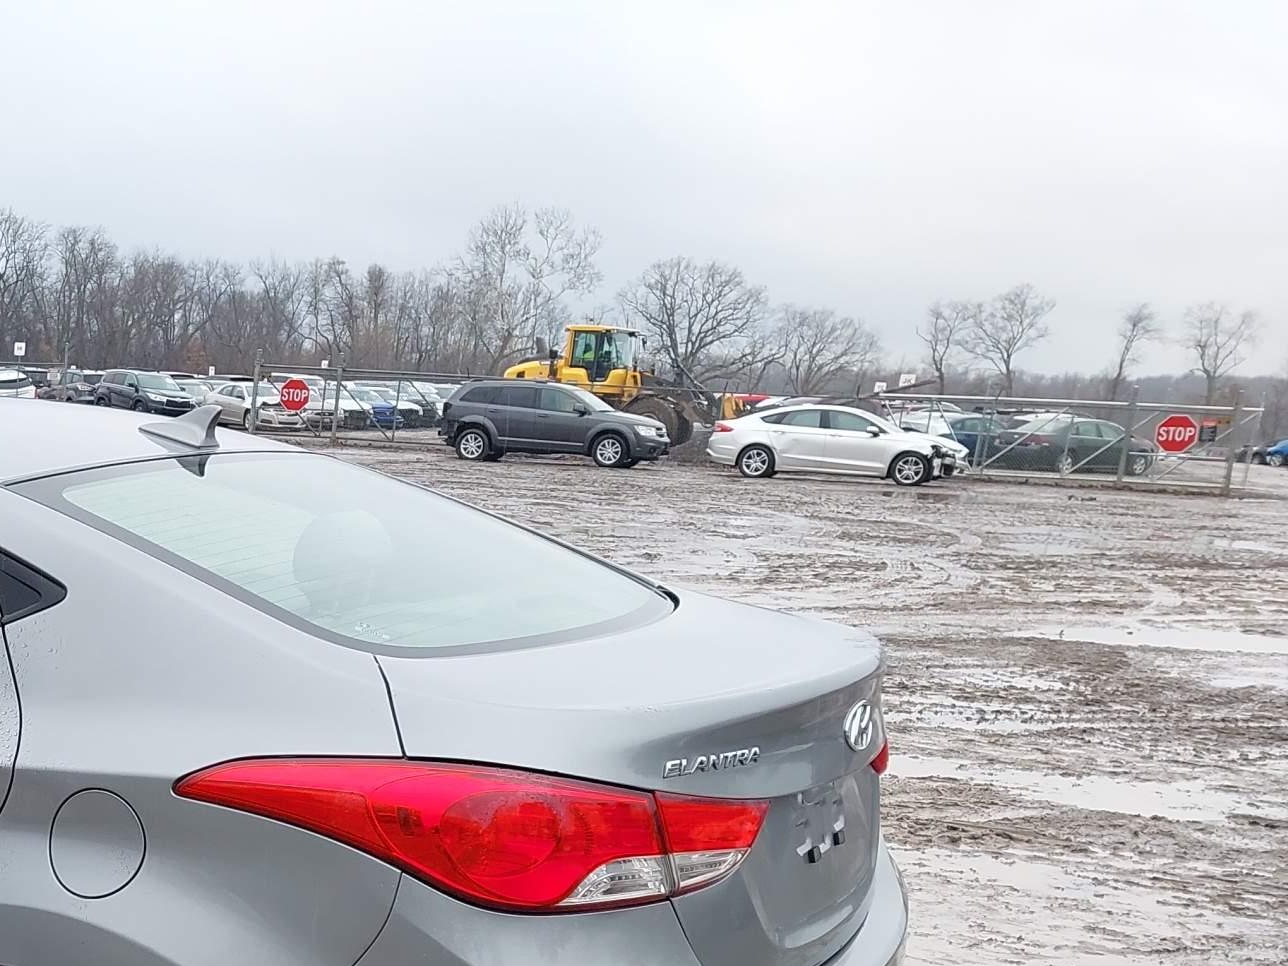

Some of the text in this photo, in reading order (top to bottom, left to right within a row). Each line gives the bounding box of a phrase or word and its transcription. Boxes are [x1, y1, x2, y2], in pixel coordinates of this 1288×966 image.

[281, 388, 309, 402] STOP
[1158, 426, 1195, 442] STOP
[663, 747, 761, 778] ELANTRA
